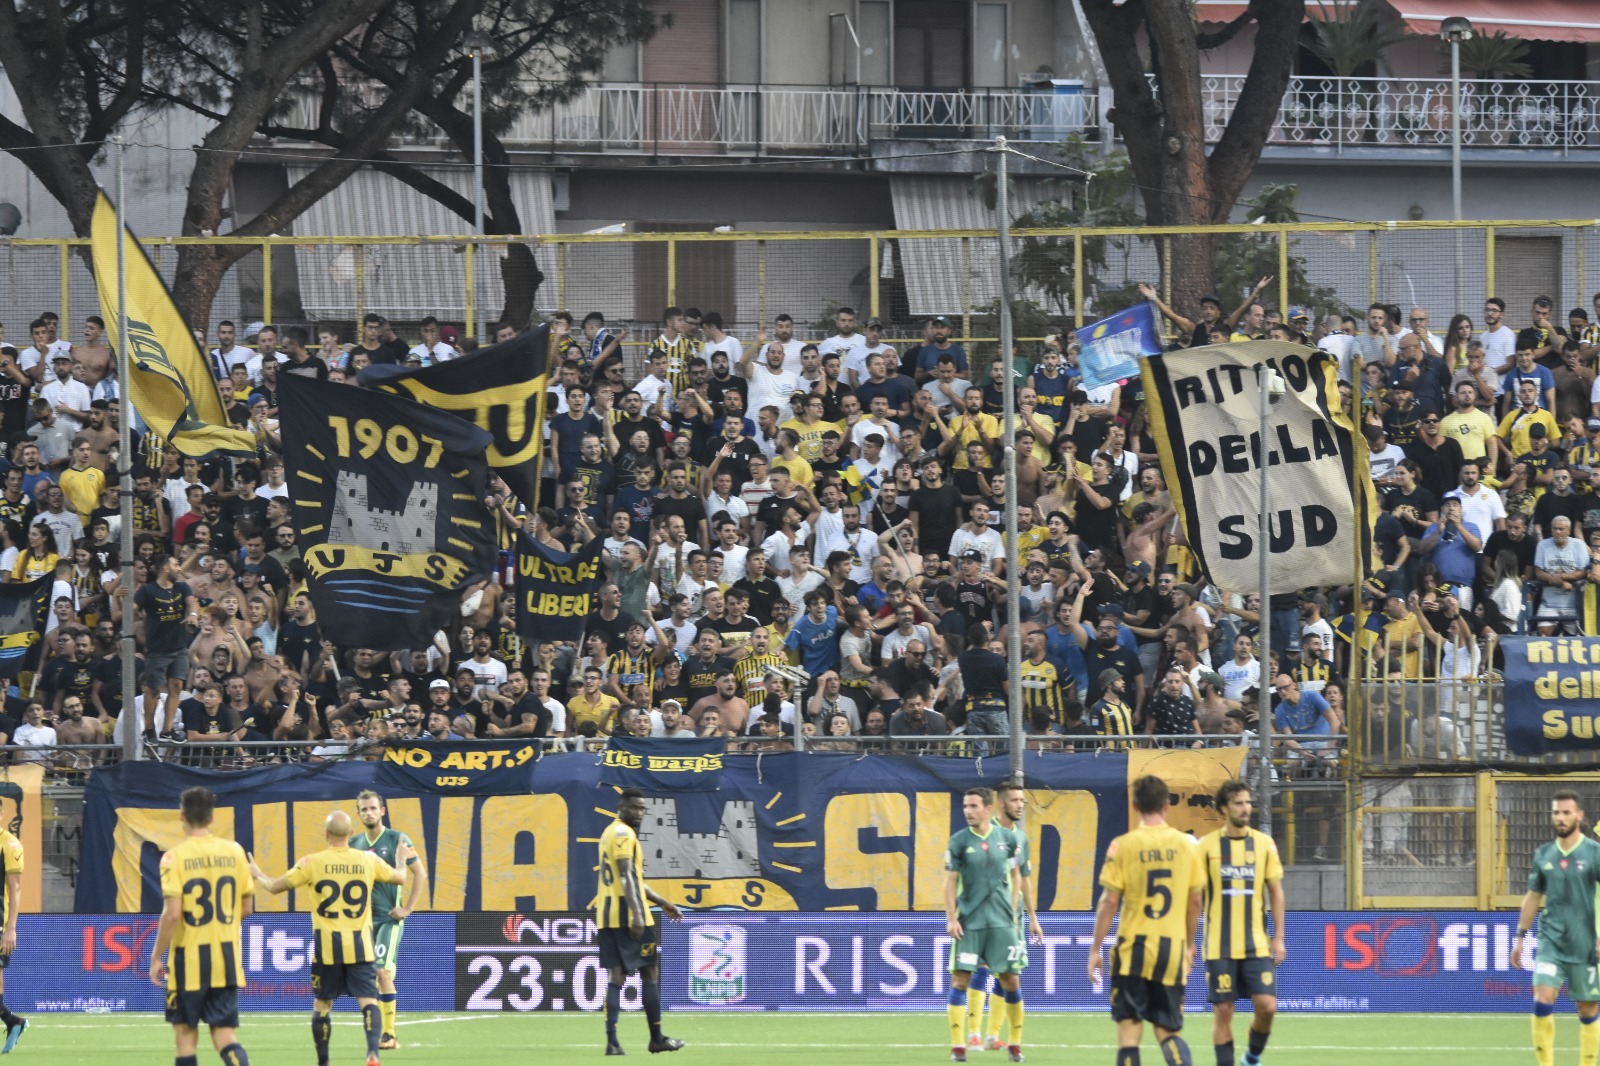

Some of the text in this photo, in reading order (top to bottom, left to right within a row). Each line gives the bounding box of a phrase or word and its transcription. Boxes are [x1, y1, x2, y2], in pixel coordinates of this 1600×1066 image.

[328, 415, 445, 468] 1907
[1188, 419, 1339, 477] DELLA
[1218, 504, 1338, 560] SUD
[383, 745, 535, 771] NO ART.9
[603, 749, 724, 773] the wasps
[435, 776, 470, 787] UJS
[324, 863, 366, 875] CARLINI
[182, 875, 237, 928] 30
[314, 879, 369, 919] 29
[1143, 868, 1172, 919] 5
[795, 935, 1117, 994] RISTT
[1217, 973, 1232, 989] 10
